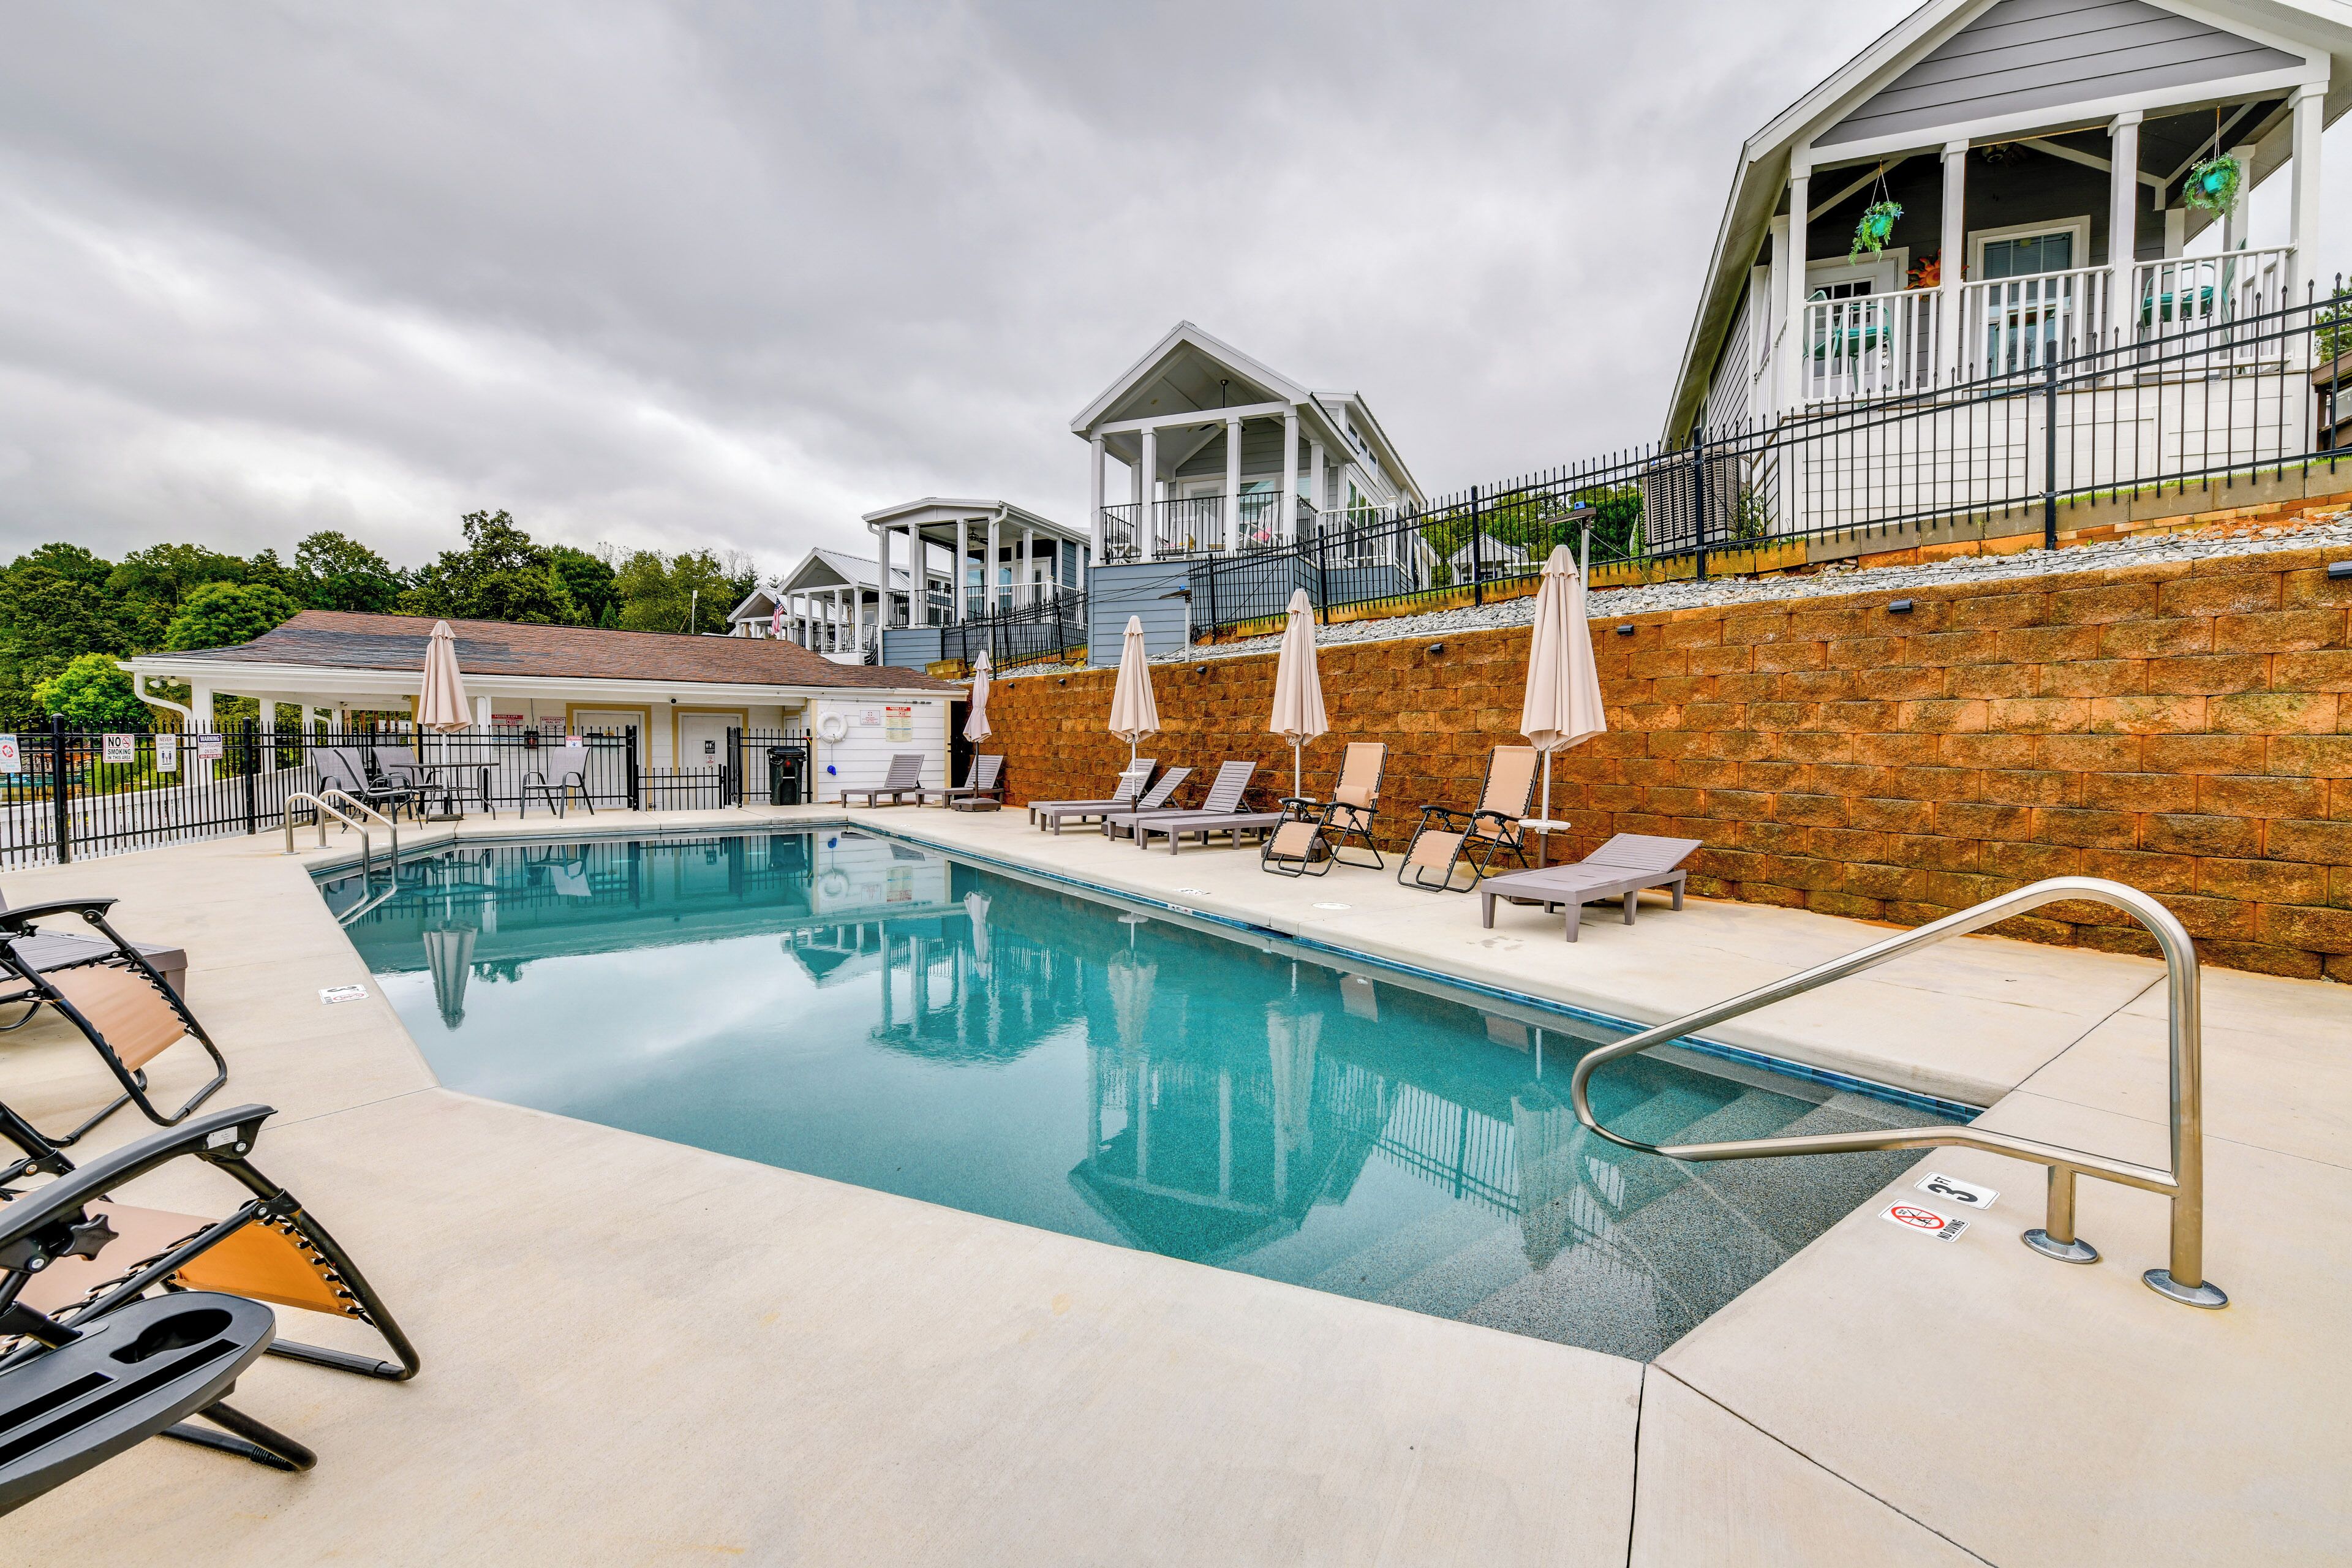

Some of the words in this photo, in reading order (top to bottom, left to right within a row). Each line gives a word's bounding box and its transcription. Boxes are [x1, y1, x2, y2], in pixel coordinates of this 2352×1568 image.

[108, 737, 121, 747] NO
[1934, 1176, 1952, 1185] FT
[1928, 1183, 1978, 1202] 3
[1944, 1219, 1965, 1234] DIVING
